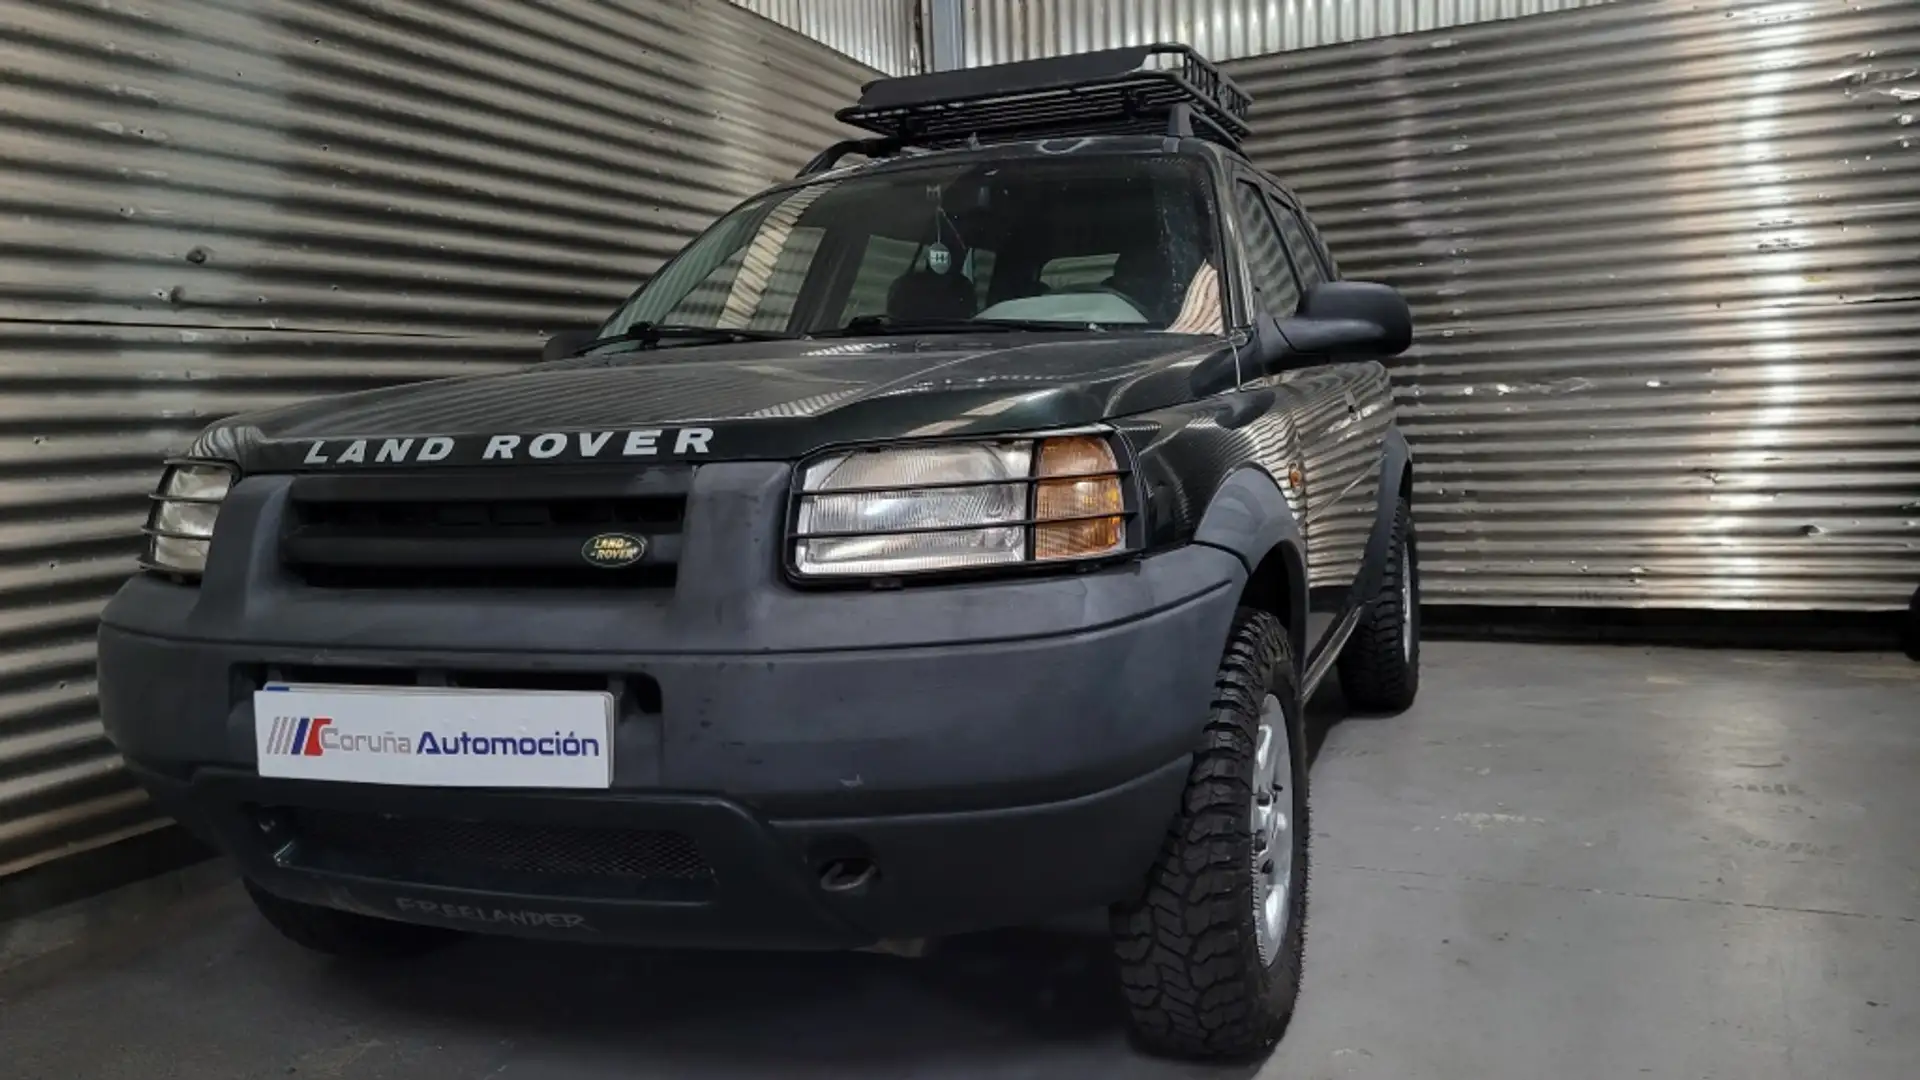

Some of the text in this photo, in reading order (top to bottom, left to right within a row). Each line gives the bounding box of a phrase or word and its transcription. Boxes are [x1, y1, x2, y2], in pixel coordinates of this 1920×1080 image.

[303, 427, 715, 465] LAND ROVER
[594, 538, 625, 549] LAND
[319, 727, 600, 757] Coruña Automoción
[395, 897, 590, 929] FREELANDER
